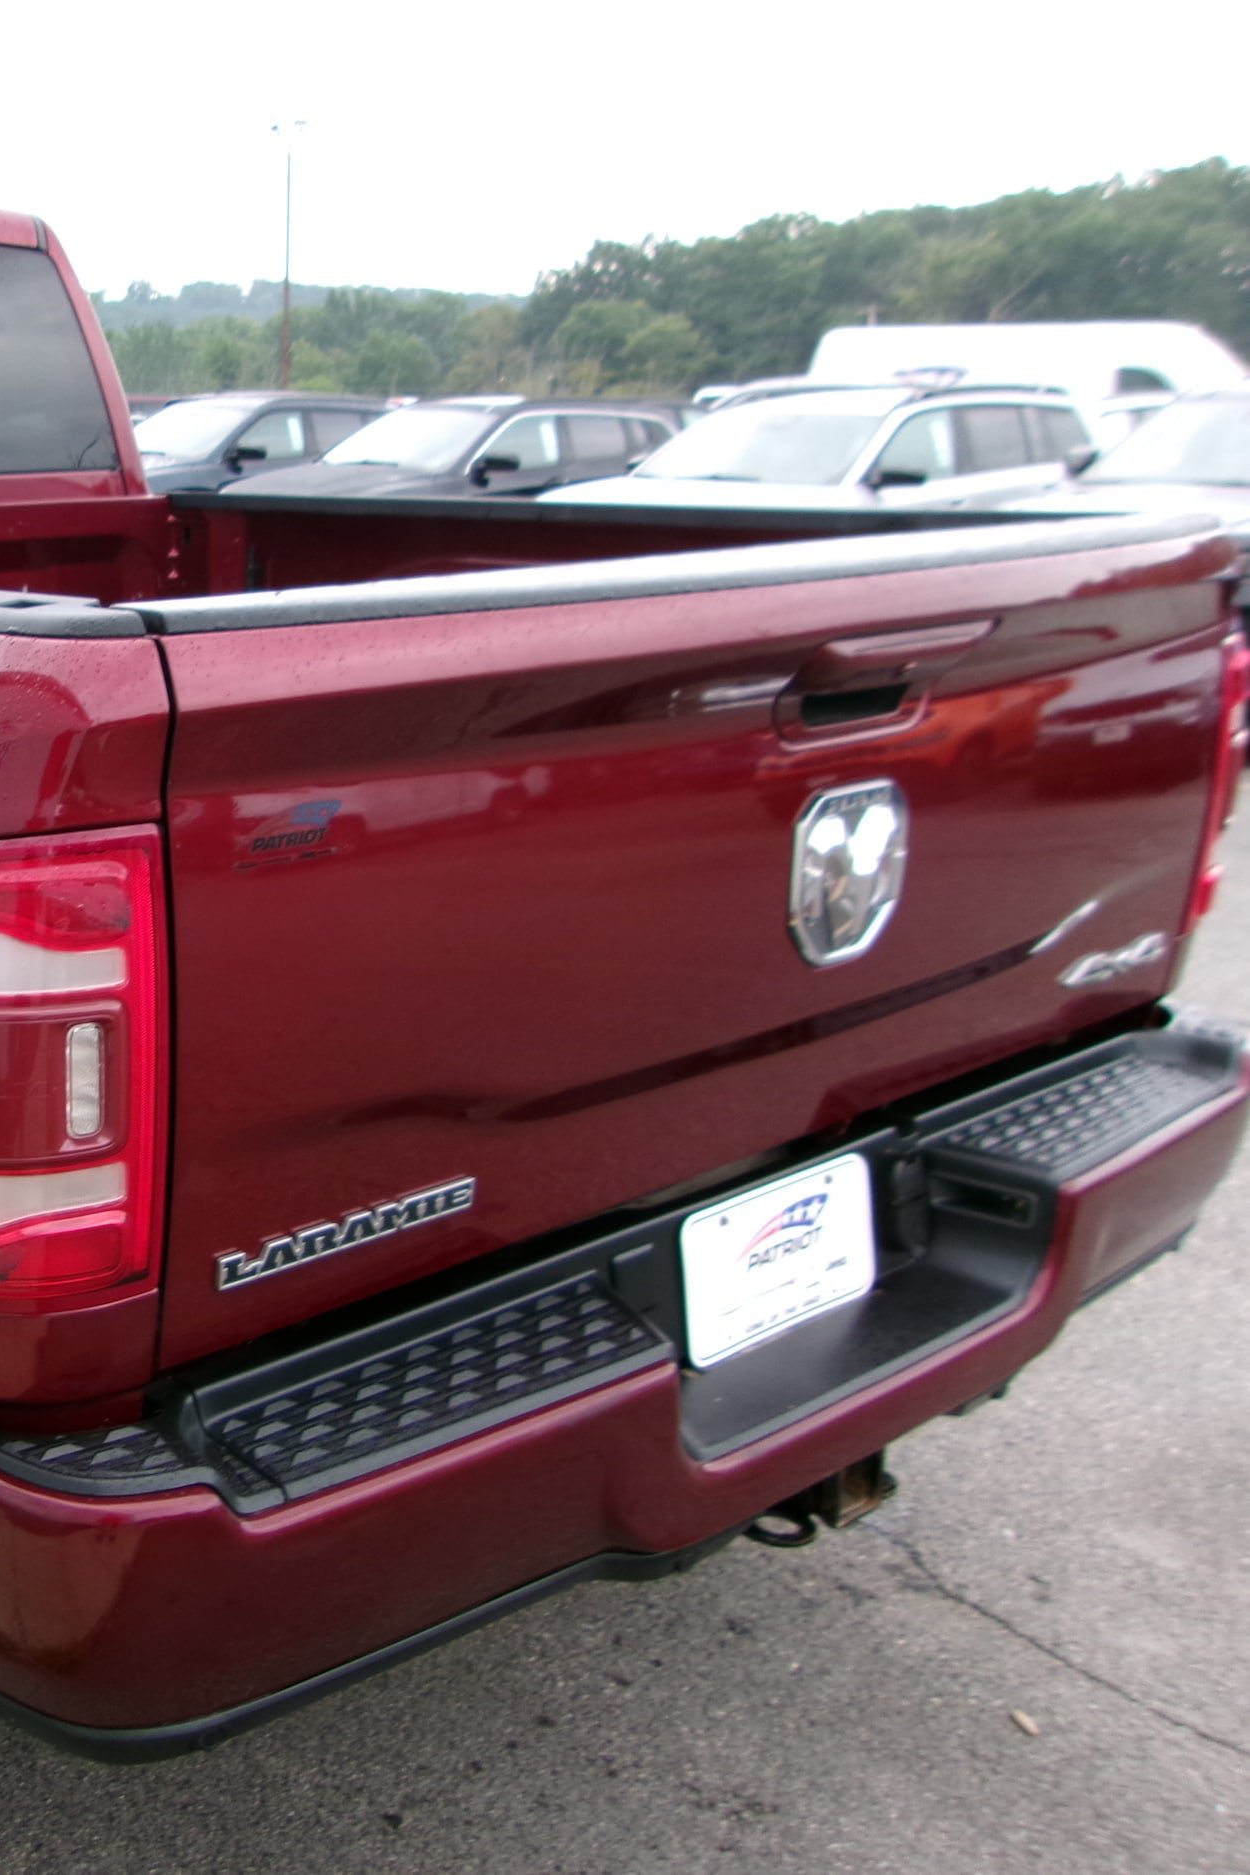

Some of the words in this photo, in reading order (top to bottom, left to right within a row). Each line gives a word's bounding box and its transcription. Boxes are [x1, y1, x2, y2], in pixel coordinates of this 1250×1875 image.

[252, 827, 327, 852] PATRIOT
[215, 1175, 477, 1291] LARAMIE
[747, 1226, 823, 1272] PATRIOT
